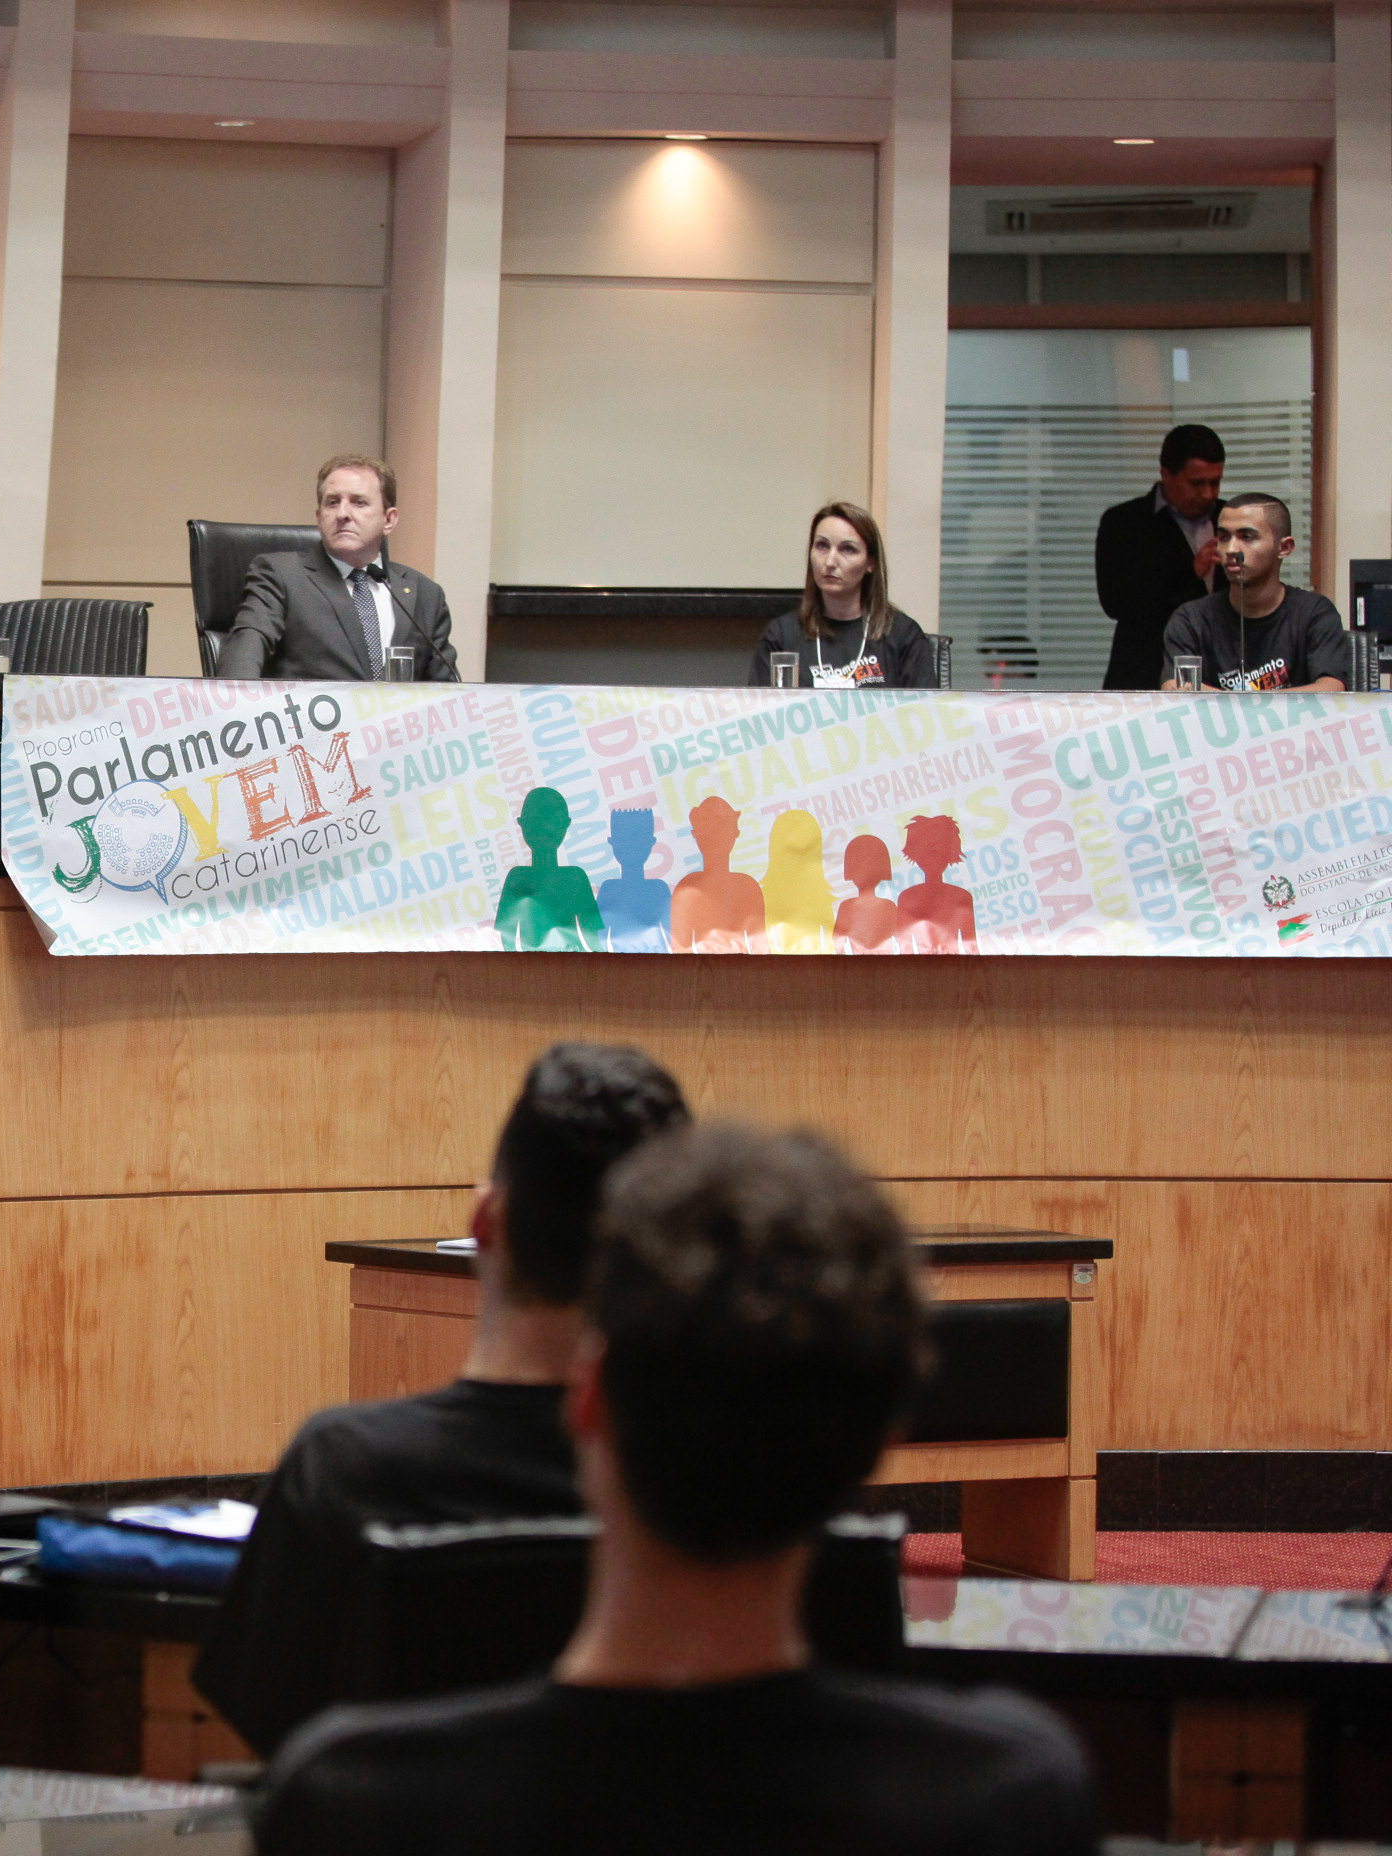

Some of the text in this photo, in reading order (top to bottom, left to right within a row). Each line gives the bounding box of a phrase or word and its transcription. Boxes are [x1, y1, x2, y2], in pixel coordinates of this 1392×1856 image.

[22, 721, 124, 762] Programa
[30, 693, 341, 817] Parlamento
[360, 692, 485, 755] DEBATE
[1215, 713, 1382, 797] DEBATE
[379, 730, 495, 798] SAÚDE
[1233, 765, 1369, 829] CULTURA
[52, 731, 374, 905] JOVEM
[388, 774, 509, 859] LEIS
[172, 809, 381, 899] catarinense
[1298, 853, 1371, 884] ASSEMBLEIA
[1300, 886, 1315, 897] DO
[1318, 874, 1355, 891] ESTADO
[262, 842, 474, 938] IGUALDADE
[1316, 898, 1362, 919] ESCOLA
